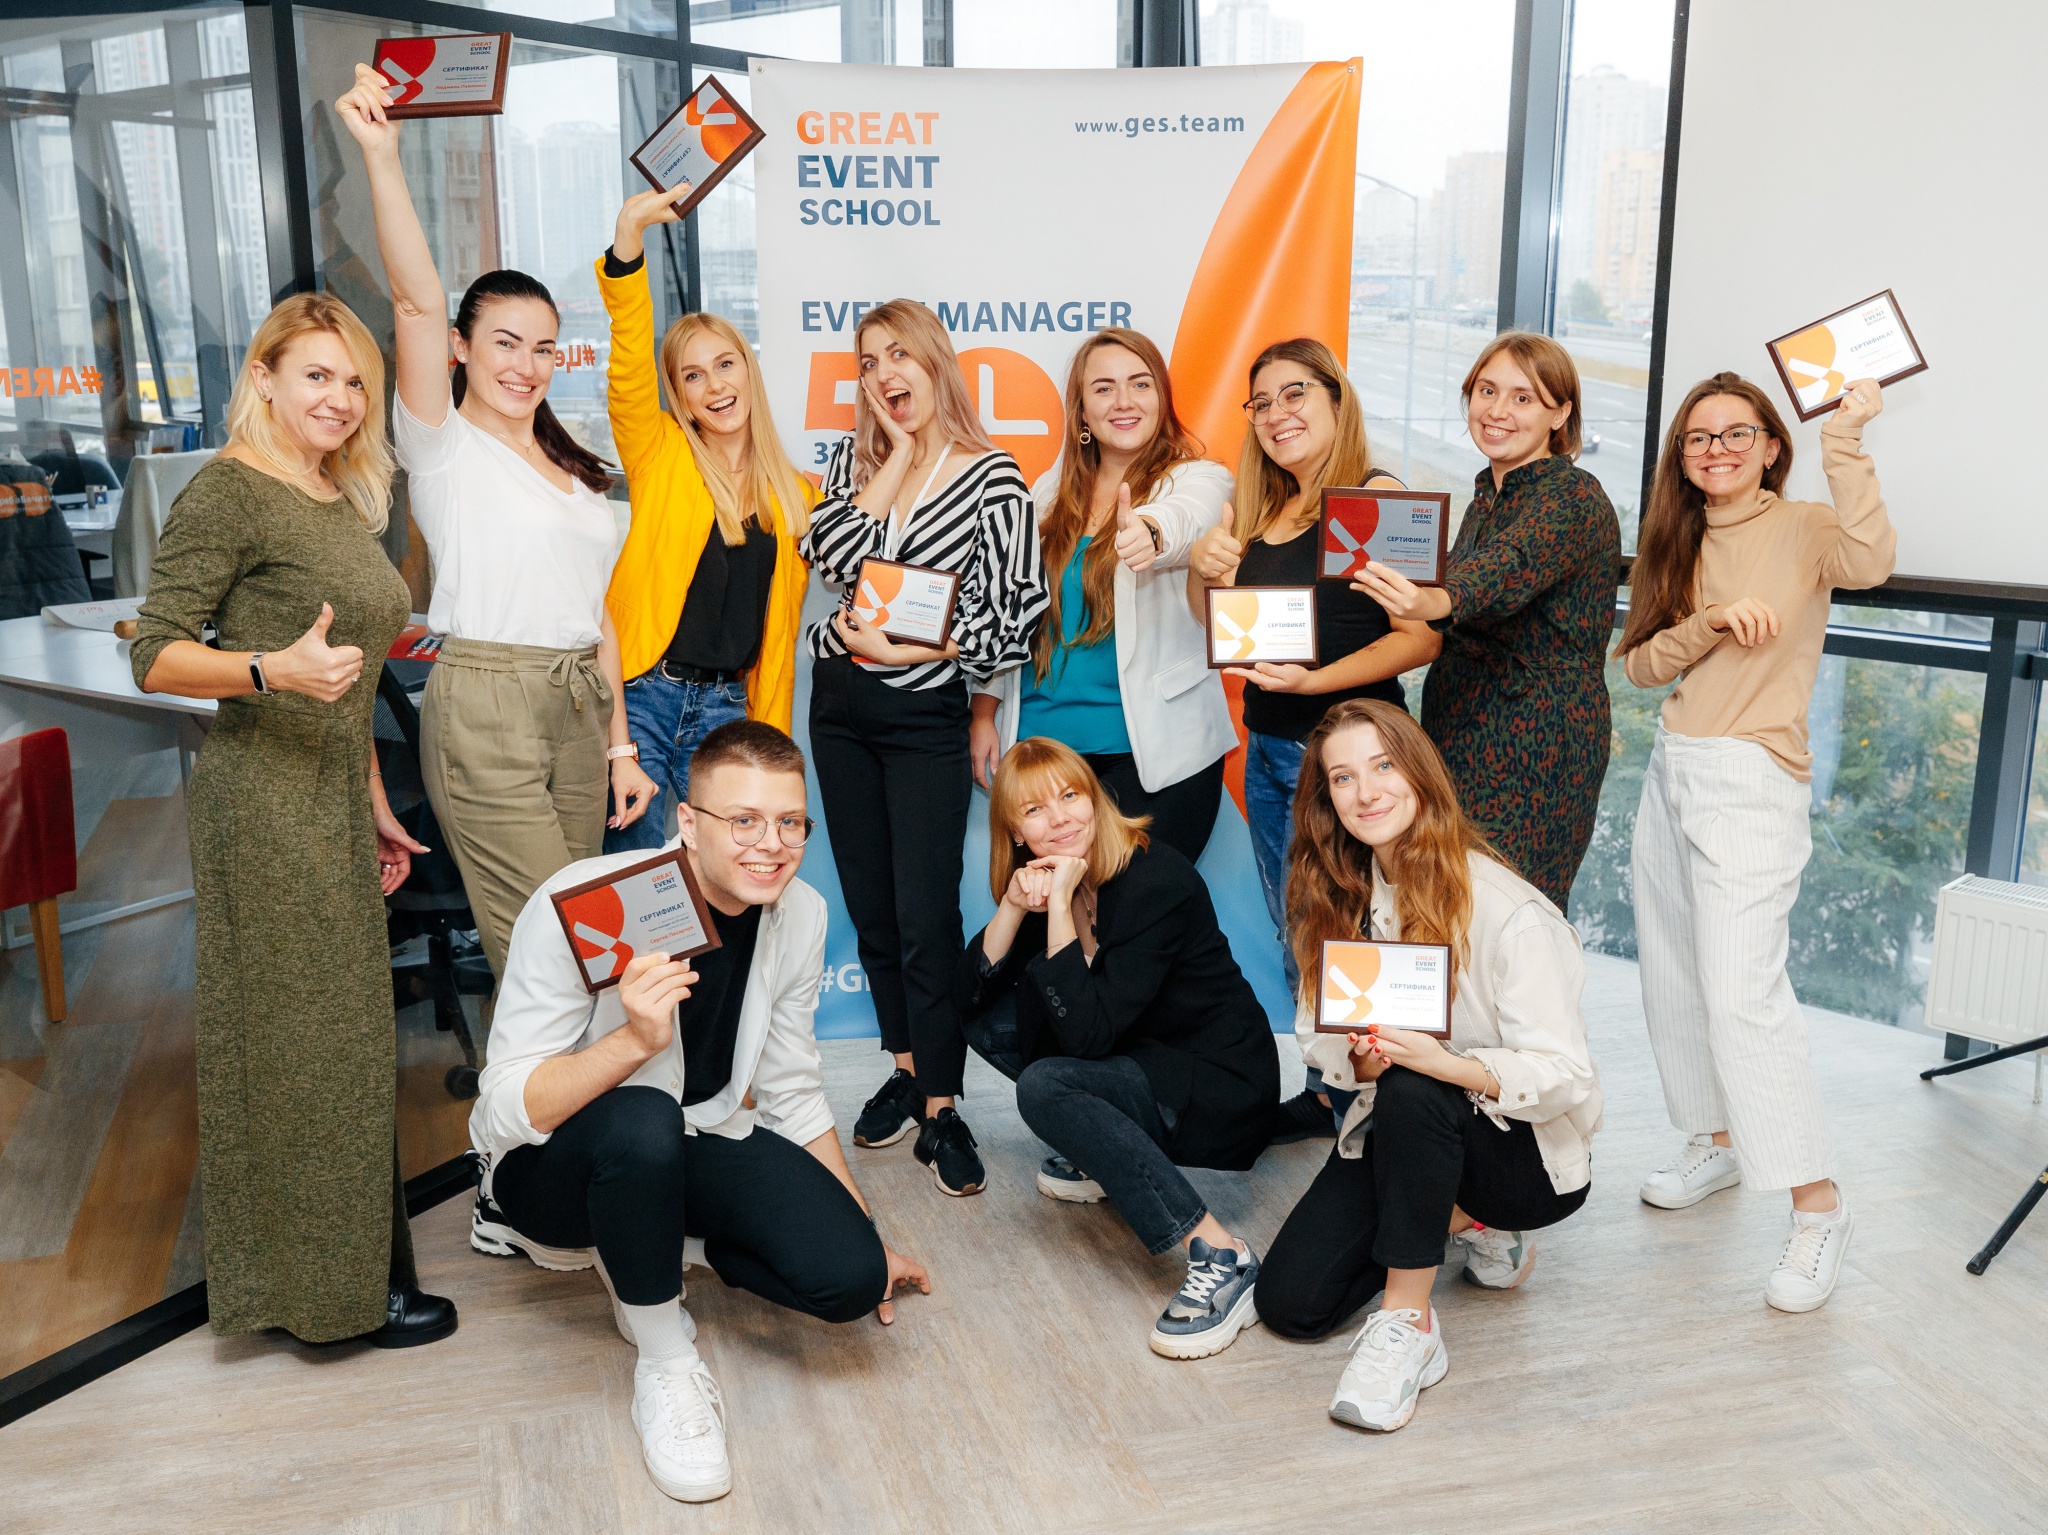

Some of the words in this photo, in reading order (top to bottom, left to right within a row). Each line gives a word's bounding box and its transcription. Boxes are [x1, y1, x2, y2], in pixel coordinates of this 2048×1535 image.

[442, 65, 489, 73] СЕРТИФИКАТ
[796, 110, 940, 145] GREAT
[1075, 114, 1245, 138] www.ges.team
[662, 147, 692, 178] СЕРТИФИКАТ
[797, 155, 940, 188] EVENT
[799, 198, 941, 226] SCHOOL
[937, 301, 1133, 333] MANAGER
[1850, 330, 1894, 353] СЕРТИФИКАТ
[1386, 536, 1431, 544] СЕРТИФИКАТ
[905, 600, 941, 610] СЕРТИФИКАТ
[651, 871, 673, 883] GREAT
[653, 877, 675, 889] EVENT
[656, 883, 678, 894] SCHOOL
[639, 902, 685, 923] СЕРТИФИКАТ
[1389, 983, 1436, 991] СЕРТИФИКАТ
